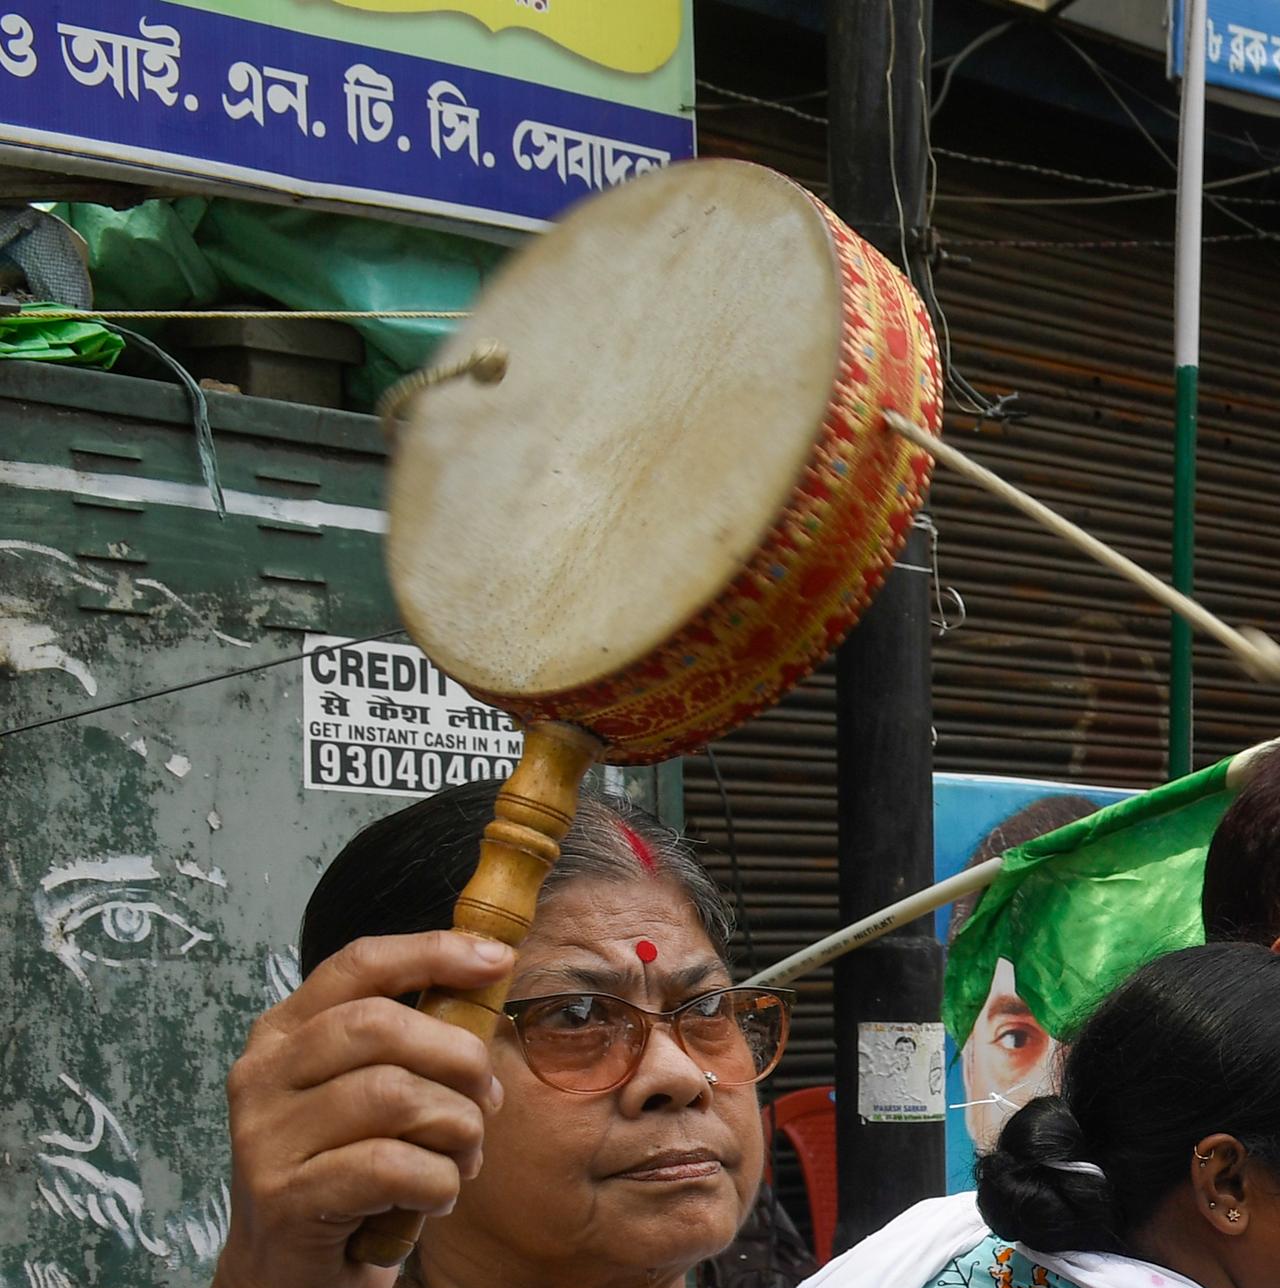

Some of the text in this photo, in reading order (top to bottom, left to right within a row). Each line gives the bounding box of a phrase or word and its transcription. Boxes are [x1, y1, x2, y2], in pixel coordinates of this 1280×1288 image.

[0, 13, 38, 78] ও
[57, 15, 199, 112] আই.
[222, 60, 327, 139] এন.
[344, 63, 411, 153] টি.
[427, 79, 495, 169] সি.
[319, 691, 351, 717] से
[367, 695, 430, 724] कैश
[310, 722, 342, 739] GET
[349, 725, 418, 746] INSTANT
[424, 732, 466, 751] CASH
[472, 736, 488, 752] IN
[494, 739, 500, 753] 1
